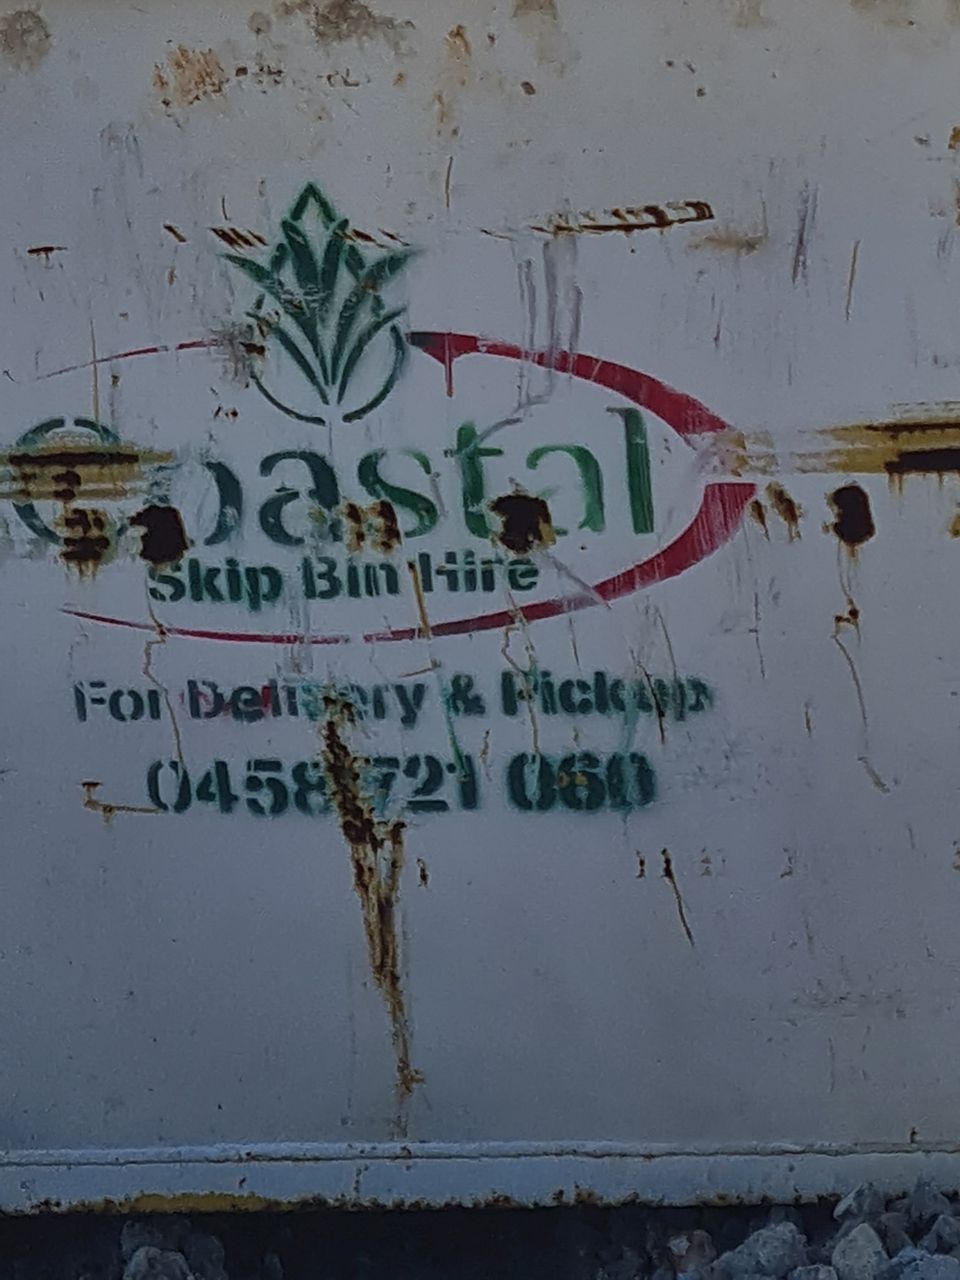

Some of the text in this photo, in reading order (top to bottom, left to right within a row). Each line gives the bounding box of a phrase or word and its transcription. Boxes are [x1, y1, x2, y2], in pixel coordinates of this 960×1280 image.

[149, 549, 540, 612] Skip Bin Hire
[73, 679, 163, 723] For
[450, 673, 486, 717] &
[147, 750, 657, 817] 0458 721 060
